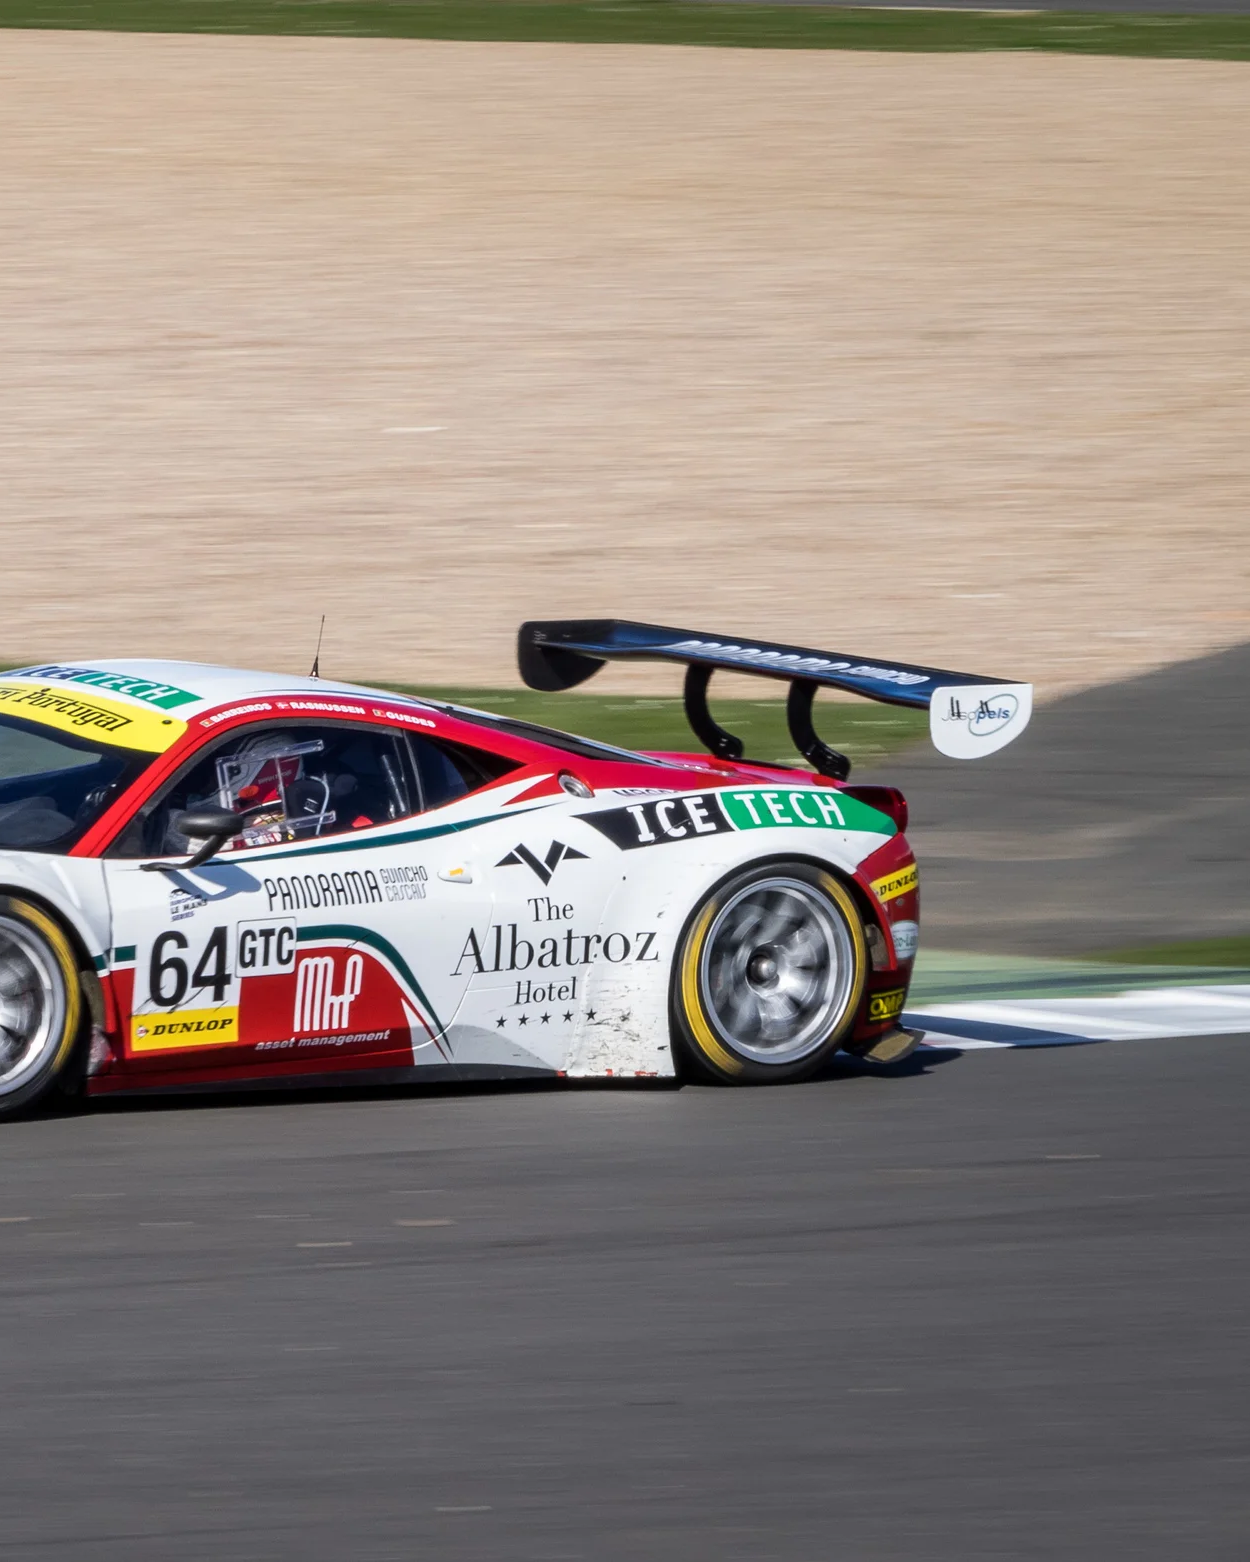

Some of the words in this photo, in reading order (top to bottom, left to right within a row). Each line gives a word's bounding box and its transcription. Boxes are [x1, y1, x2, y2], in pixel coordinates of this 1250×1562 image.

[85, 670, 180, 702] TECH
[14, 690, 133, 732] Portugal
[210, 703, 272, 723] BARREIROS
[290, 702, 366, 715] RASMUSSEN
[385, 711, 437, 728] GUEDES
[626, 797, 716, 842] ICE
[733, 792, 846, 826] TECH
[264, 870, 383, 911] PANORAMA
[527, 896, 575, 922] The
[239, 926, 295, 969] GTC
[449, 923, 661, 976] Albatroz
[149, 925, 231, 1007] 64
[514, 976, 577, 1005] Hotel
[870, 993, 904, 1016] OMP
[151, 1018, 233, 1036] DUNLOP
[255, 1037, 296, 1051] asset
[297, 1029, 391, 1048] management
